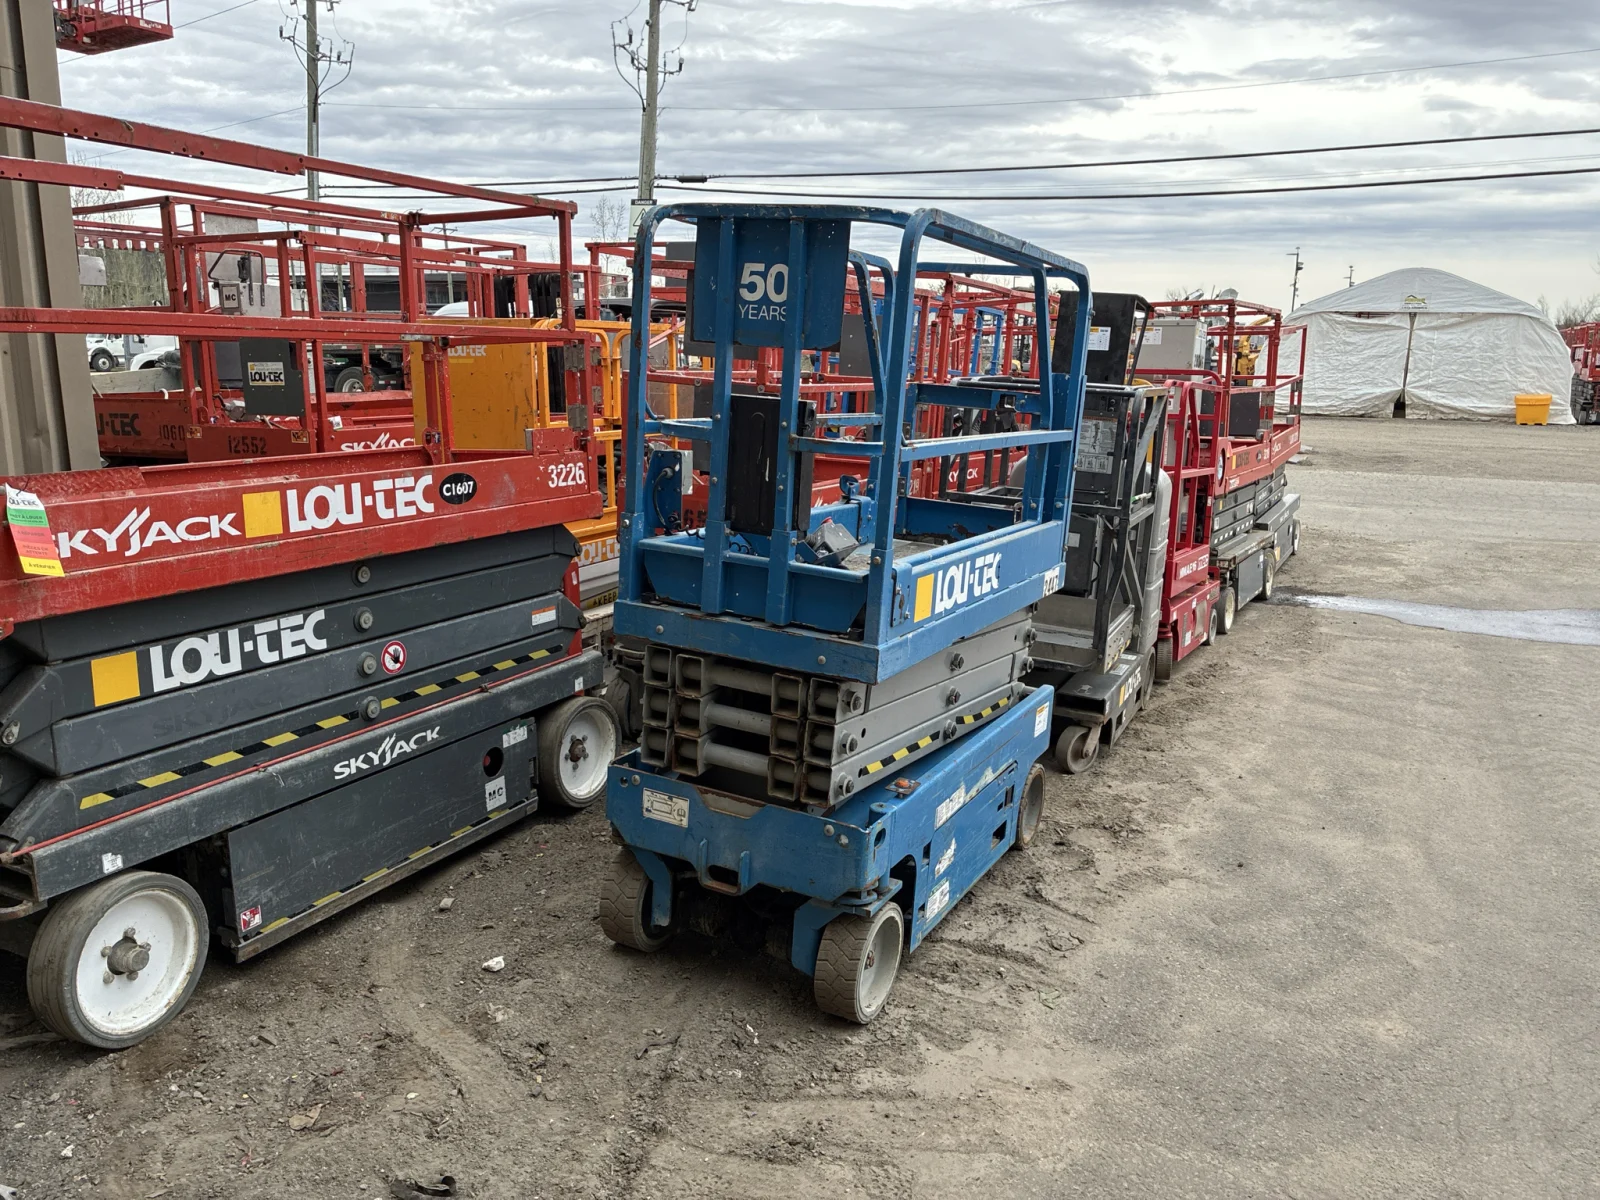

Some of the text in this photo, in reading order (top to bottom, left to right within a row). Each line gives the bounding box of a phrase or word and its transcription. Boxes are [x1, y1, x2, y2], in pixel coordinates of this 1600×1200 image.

[739, 262, 789, 303] 50
[225, 293, 236, 301] MC
[548, 462, 586, 488] 3226
[442, 481, 474, 496] C1607
[52, 505, 242, 559] KYJACK
[333, 726, 441, 780] SKYJACK
[488, 787, 503, 801] MC
